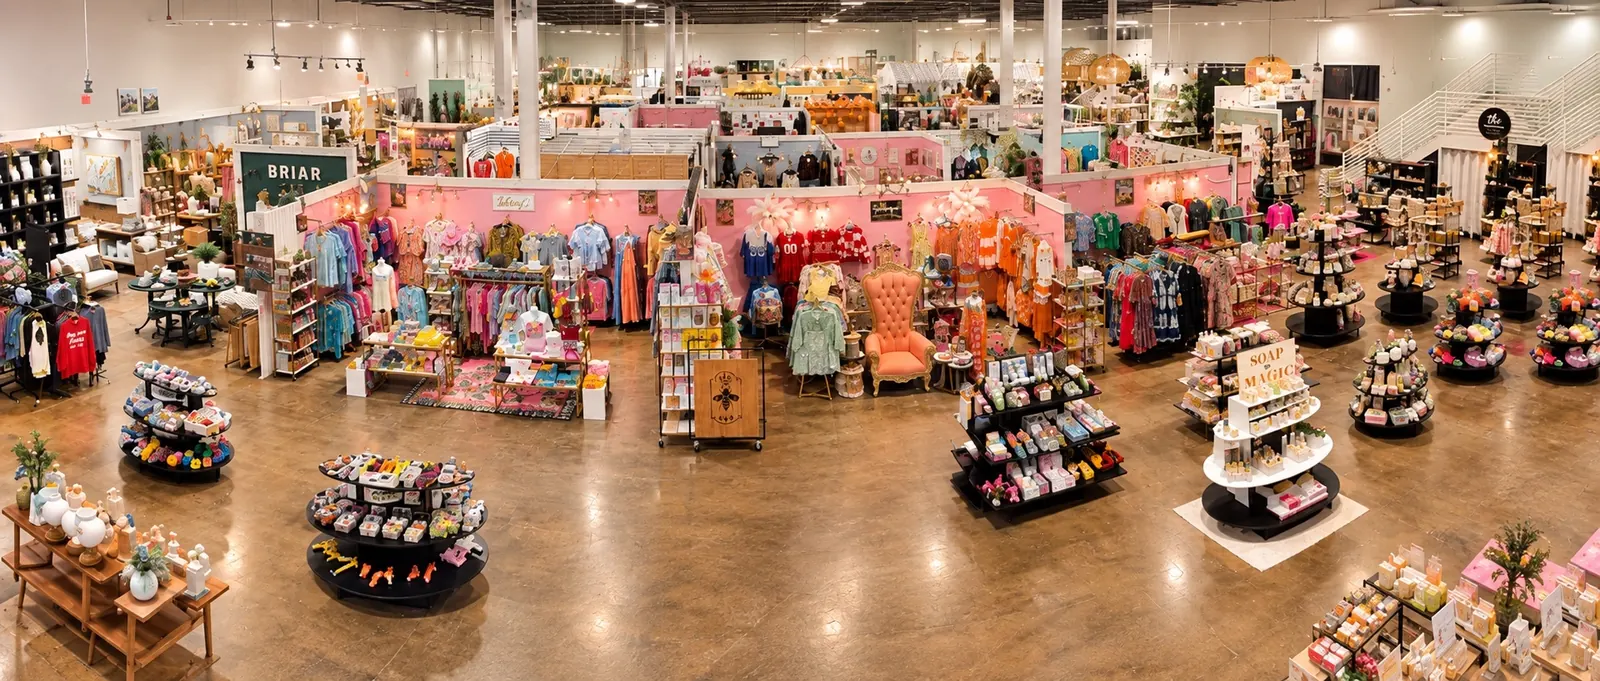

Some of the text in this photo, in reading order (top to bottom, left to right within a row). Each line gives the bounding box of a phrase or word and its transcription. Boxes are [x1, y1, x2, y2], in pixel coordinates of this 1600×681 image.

[268, 164, 321, 181] BRIAR
[784, 243, 797, 254] 00
[1250, 347, 1284, 367] SOAP
[1245, 364, 1294, 389] MAGIC
